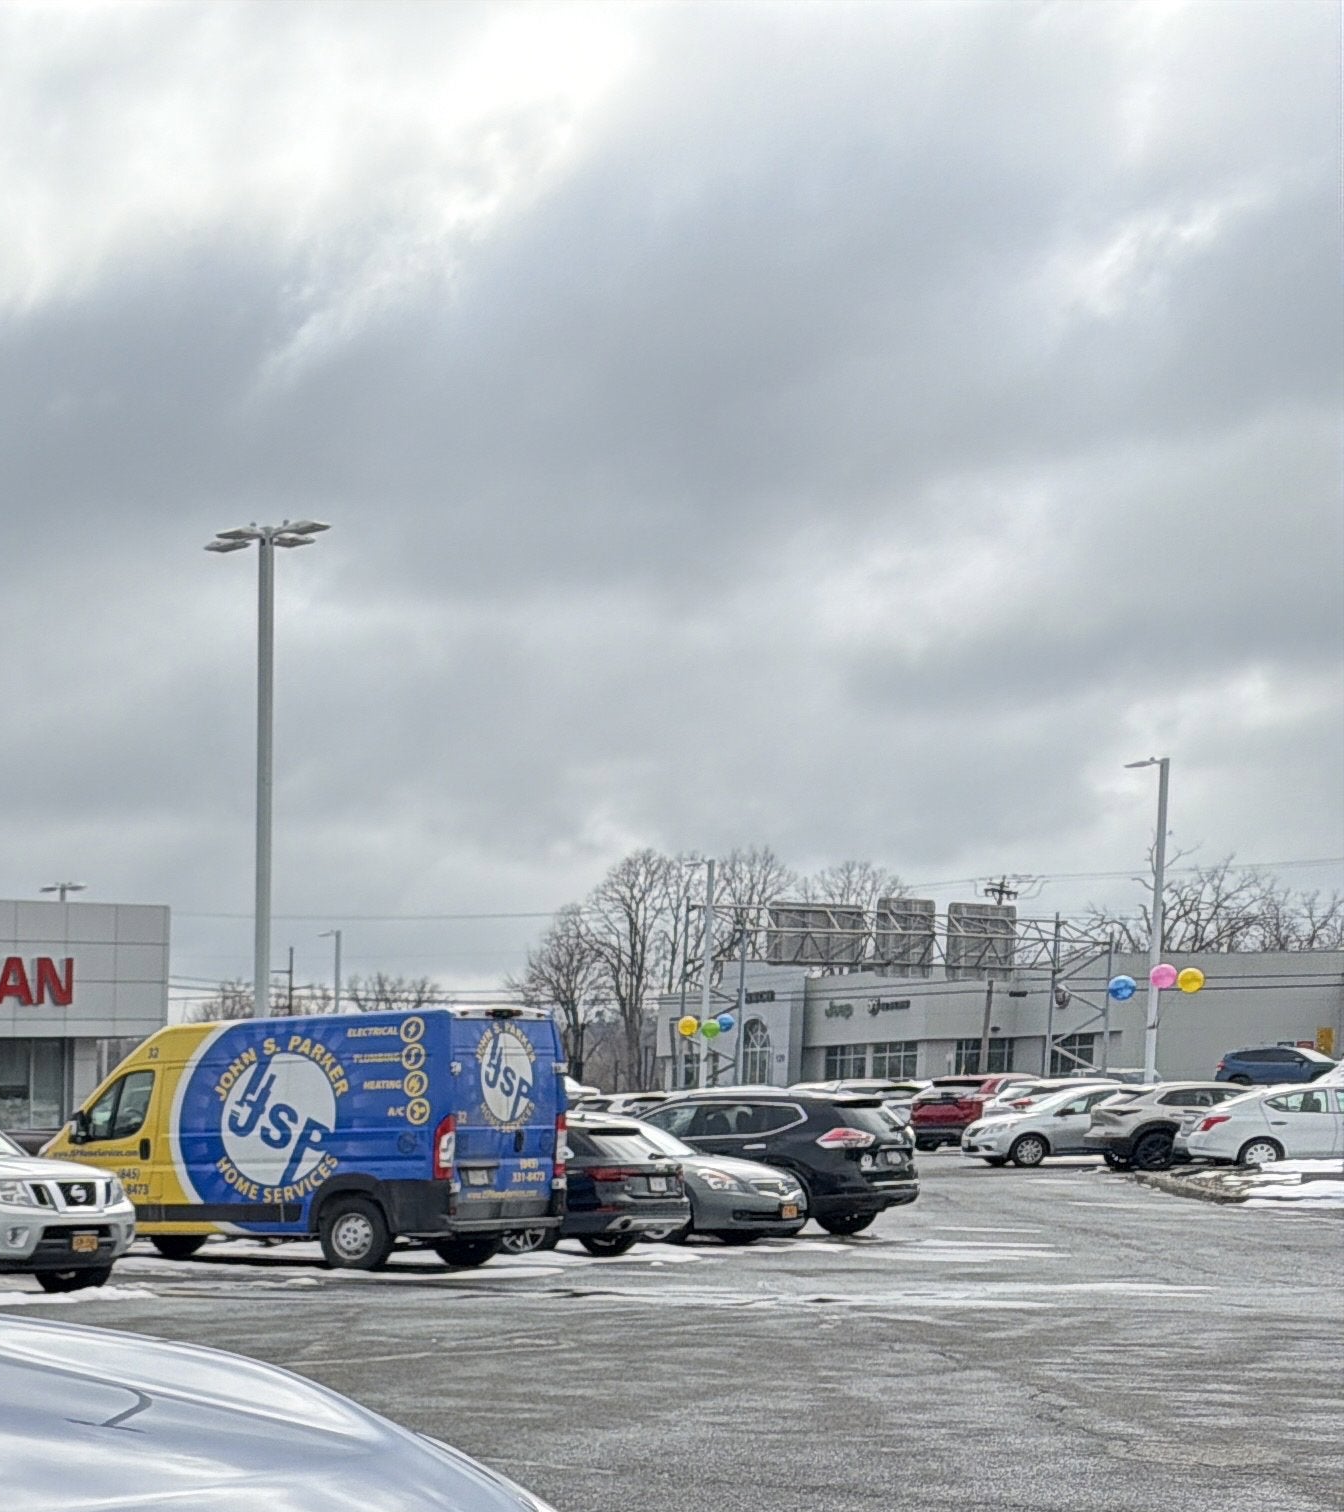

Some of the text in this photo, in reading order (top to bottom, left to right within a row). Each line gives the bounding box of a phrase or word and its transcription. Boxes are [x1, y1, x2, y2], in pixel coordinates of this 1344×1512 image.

[347, 1026, 398, 1038] ELECTRICAL
[214, 1035, 350, 1101] JOHN S. PARKER
[363, 1080, 402, 1091] HEATING
[484, 1034, 534, 1119] JSP
[228, 1054, 336, 1186] JSP
[387, 1106, 406, 1117] A/C
[216, 1153, 340, 1204] HOME SERVICES
